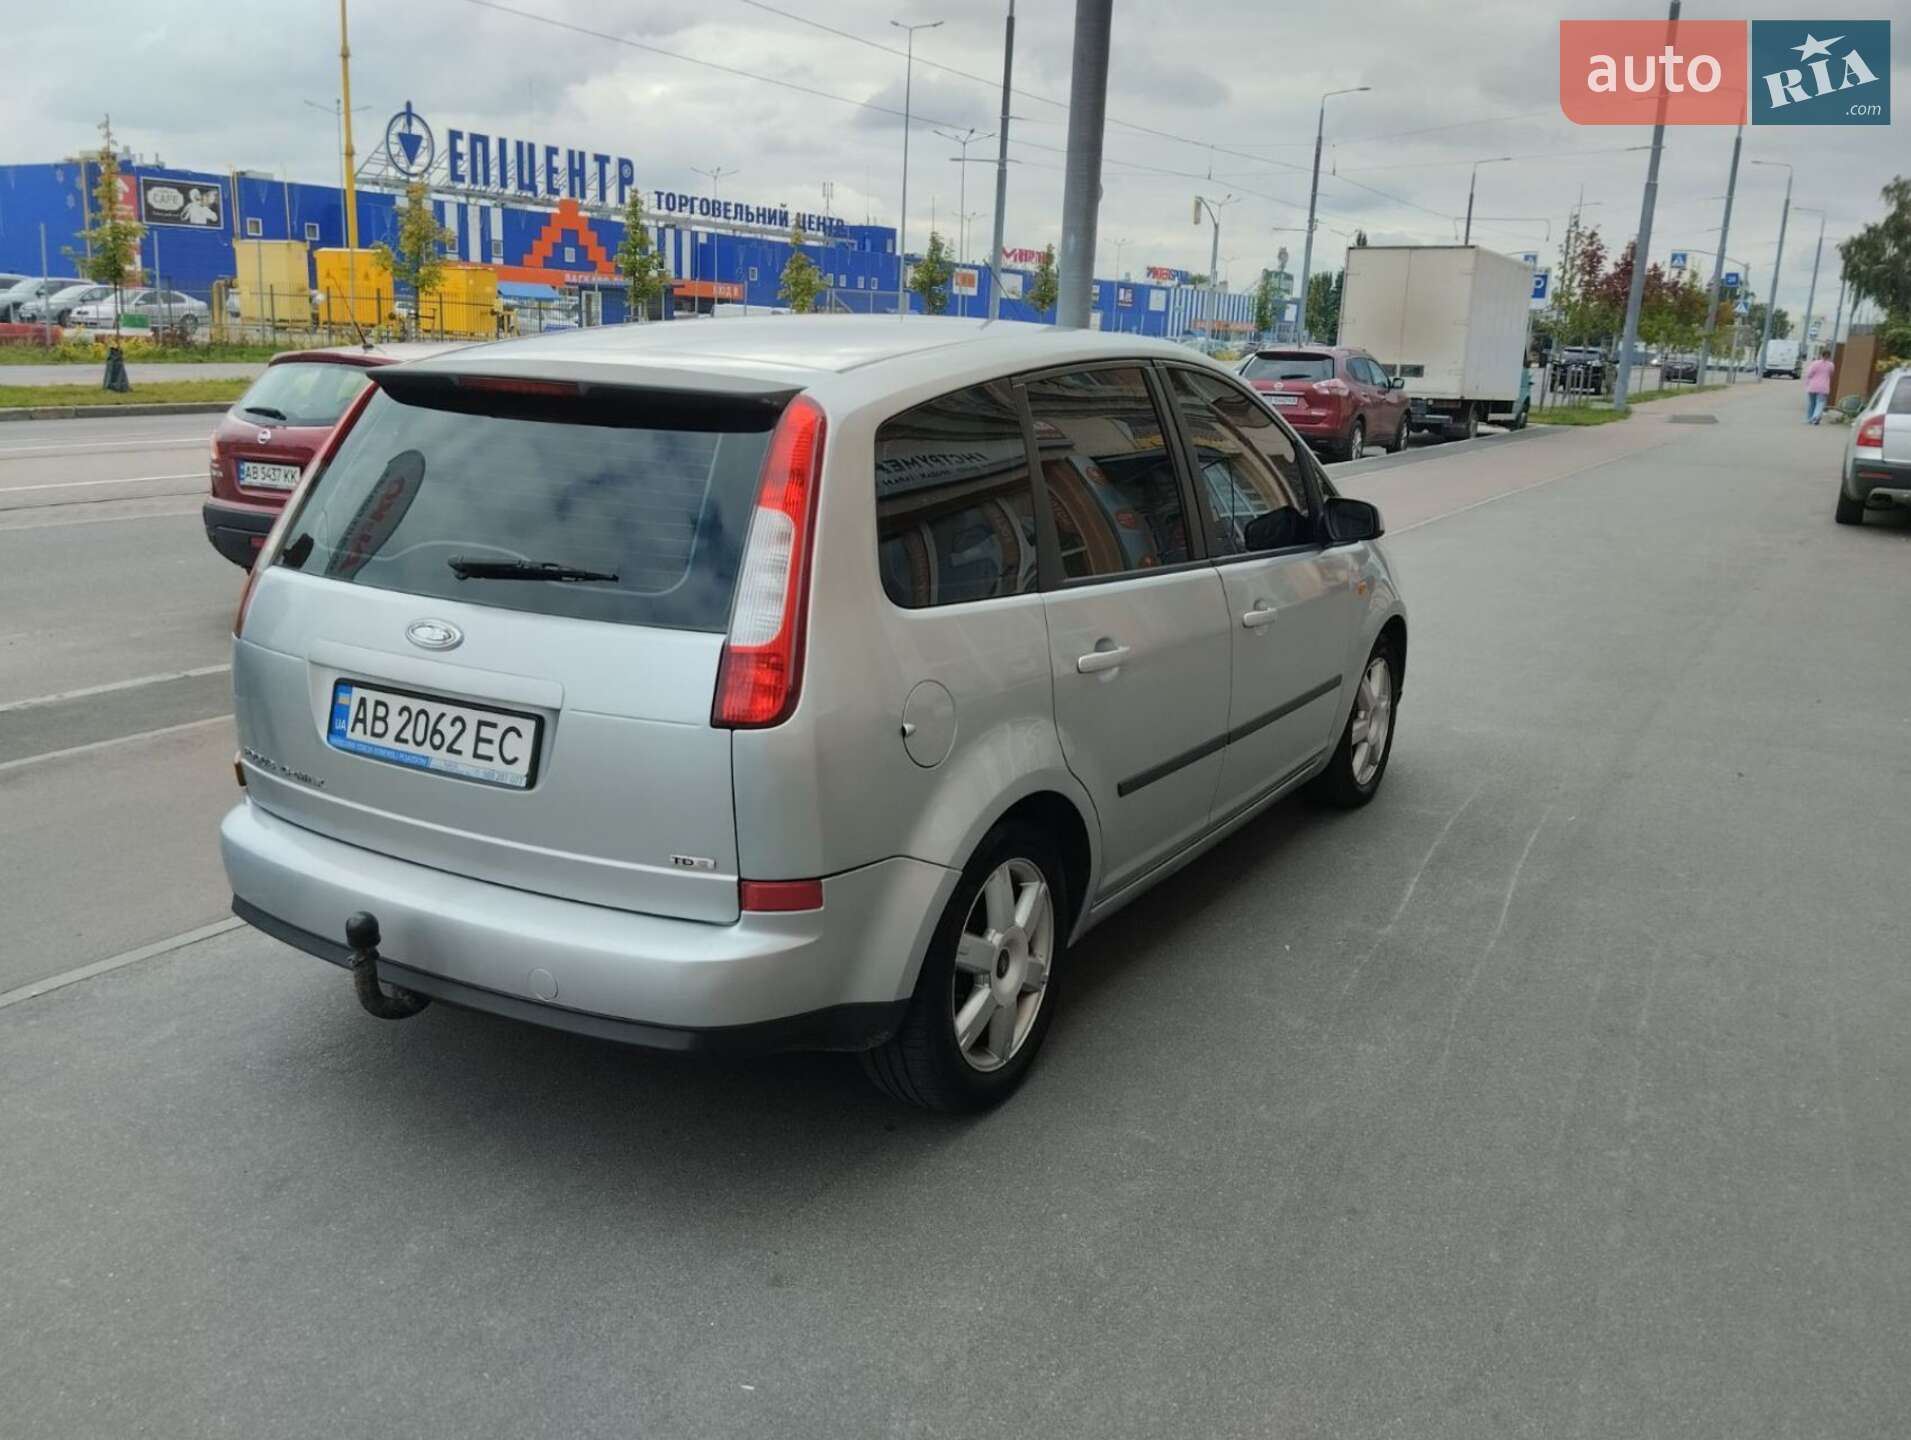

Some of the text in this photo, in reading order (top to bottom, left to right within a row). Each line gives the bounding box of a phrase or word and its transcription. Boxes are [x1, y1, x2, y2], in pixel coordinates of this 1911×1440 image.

[448, 128, 635, 204] ЕПІЦЕНТР
[654, 190, 846, 238] ТОРГОВЕЛЬНИЙ ЦЕНТР
[335, 717, 347, 731] UA
[351, 696, 389, 739] AB
[393, 704, 467, 756] 2062
[472, 719, 523, 766] EC
